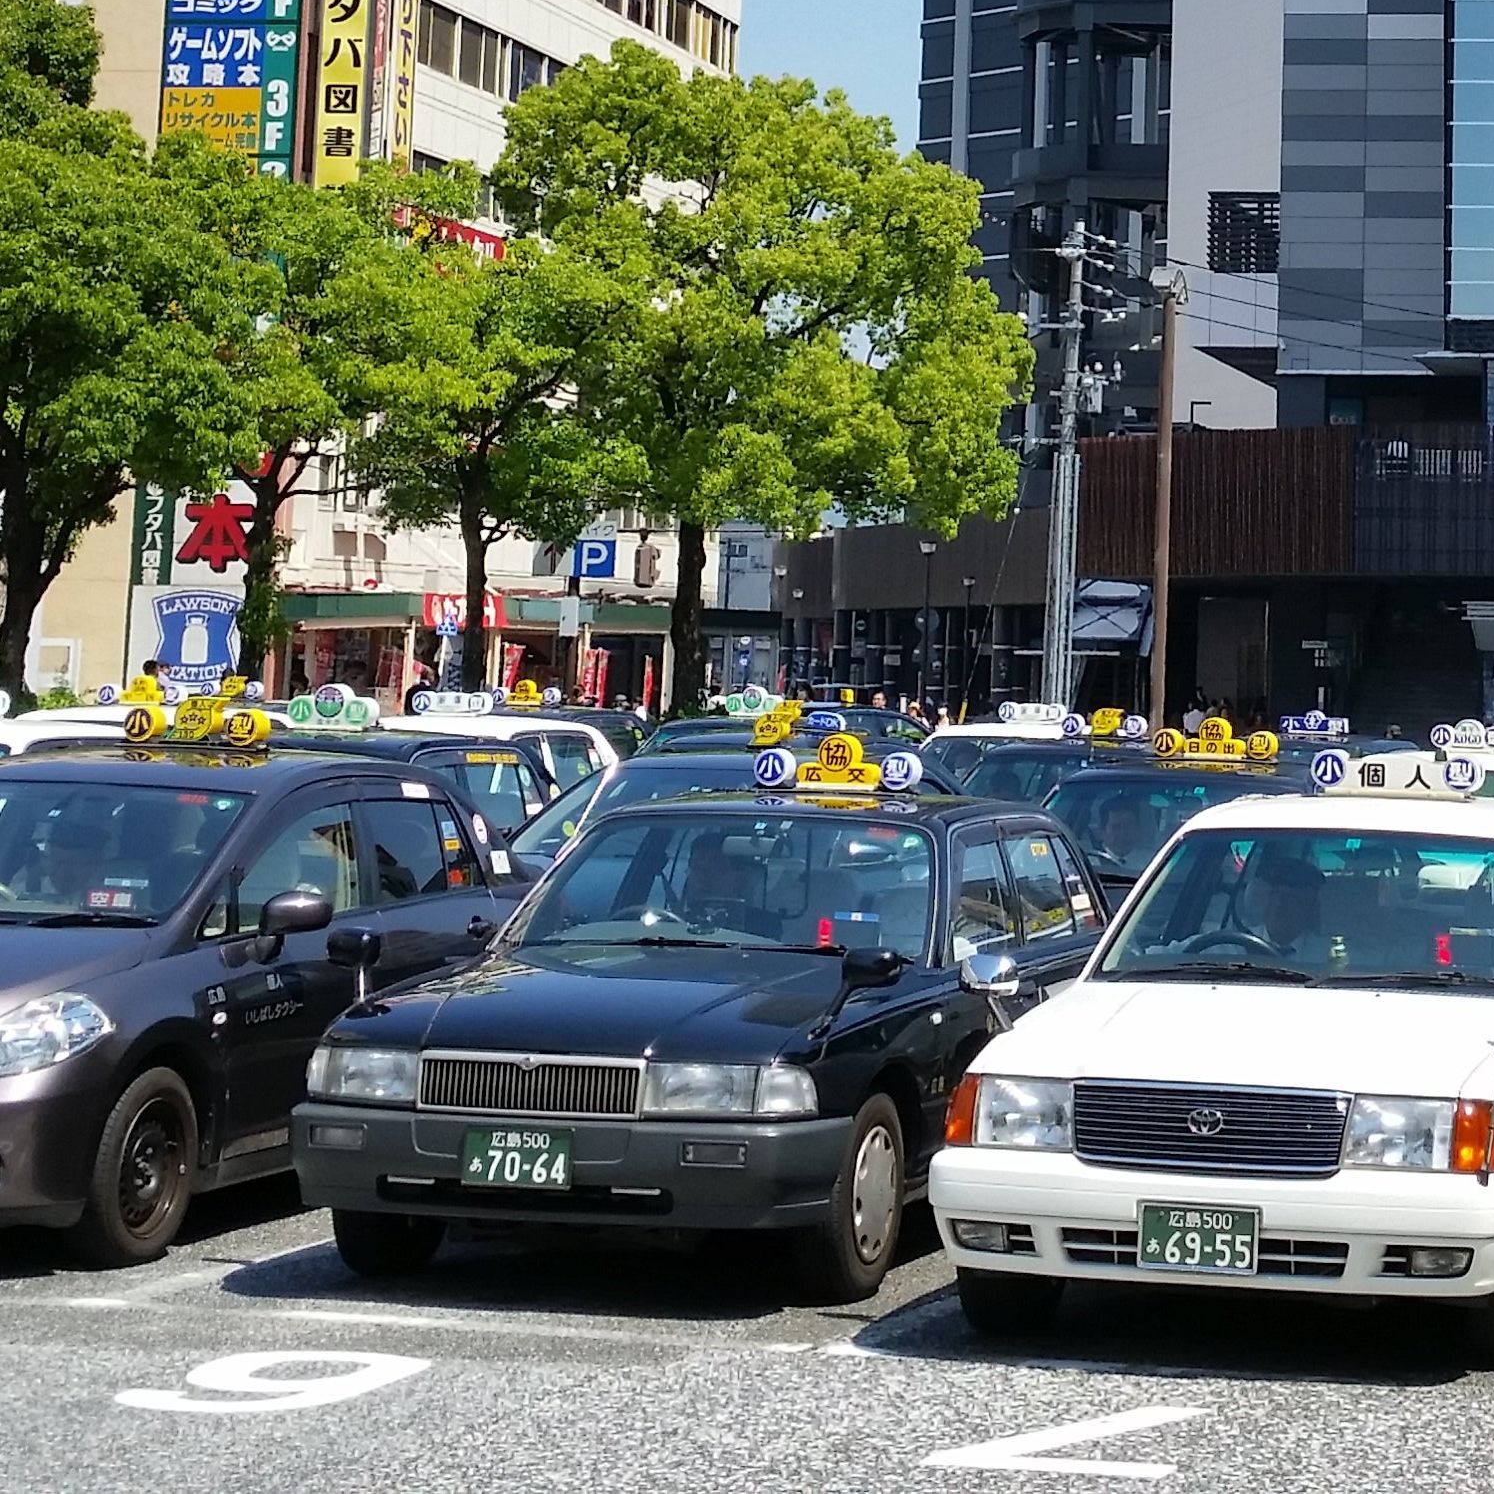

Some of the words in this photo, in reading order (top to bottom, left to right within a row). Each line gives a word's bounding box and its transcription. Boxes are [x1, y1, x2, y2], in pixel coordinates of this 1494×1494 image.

[169, 27, 262, 61] ゲームソフト
[167, 63, 261, 86] 攻略本
[168, 92, 215, 108] トレカ
[166, 112, 257, 128] リサイクル本
[141, 495, 164, 585] フタバ図書
[175, 493, 256, 573] 本
[586, 524, 615, 537] イク
[581, 541, 609, 575] P
[160, 594, 235, 615] LAWSON
[170, 662, 227, 680] TATION
[126, 710, 149, 734] 小
[229, 715, 253, 738] 型
[824, 742, 847, 766] 協
[1155, 733, 1173, 751] 小
[1189, 742, 1235, 754] 日の出
[758, 749, 784, 778] 小
[805, 767, 865, 782] 広交
[885, 758, 908, 782] 型
[1315, 756, 1341, 781] 小
[1447, 762, 1473, 786] 型
[1358, 762, 1431, 790] 個人
[245, 999, 304, 1025] いしばしタクシー
[491, 1130, 550, 1151] 広島500
[469, 1157, 482, 1173] あ
[487, 1150, 567, 1185] 70-64
[1168, 1210, 1233, 1231] 広島500
[1146, 1237, 1160, 1254] あ
[1165, 1230, 1252, 1267] 69-55
